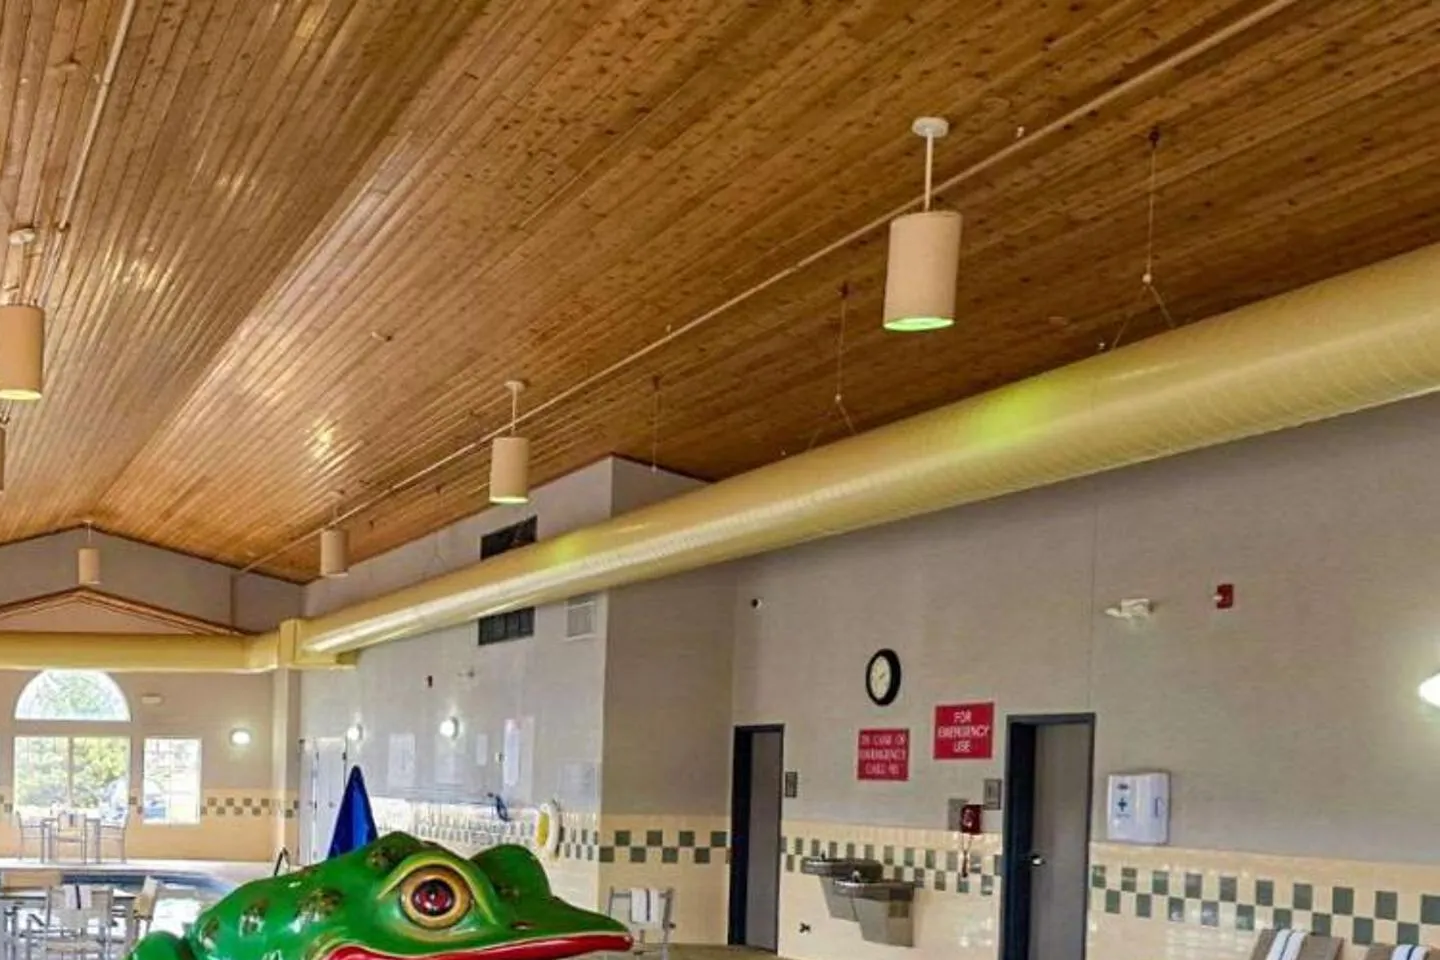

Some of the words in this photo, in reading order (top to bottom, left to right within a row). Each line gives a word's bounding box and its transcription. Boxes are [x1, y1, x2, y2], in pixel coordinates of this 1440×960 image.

[953, 710, 972, 724] FOR
[938, 724, 990, 739] EMERGENCY
[954, 740, 972, 753] USE
[859, 748, 906, 761] EMERGENCY
